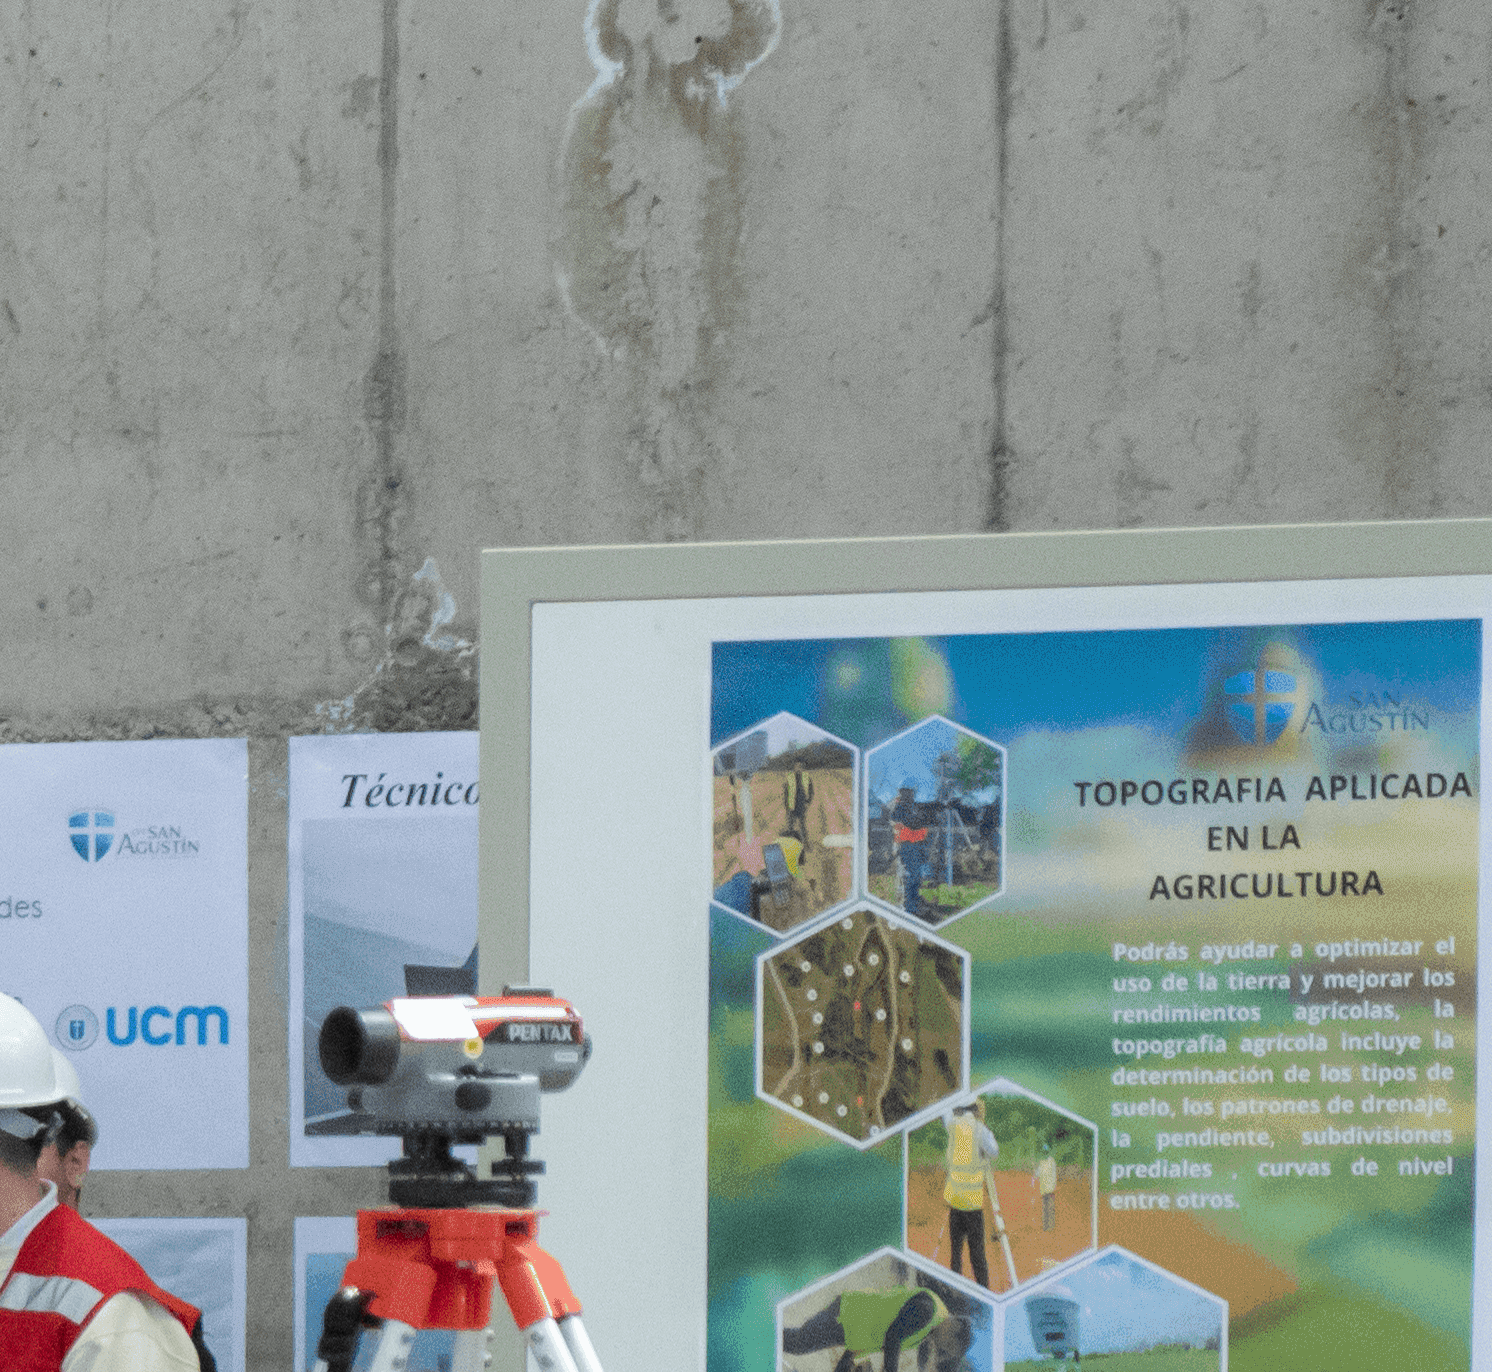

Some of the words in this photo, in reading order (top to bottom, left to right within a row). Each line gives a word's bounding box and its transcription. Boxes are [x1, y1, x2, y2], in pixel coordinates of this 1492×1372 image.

[1348, 690, 1401, 708] SAN
[341, 771, 480, 808] Técnico
[1073, 777, 1288, 807] TOPOGRAFIA
[1305, 772, 1473, 801] APLICADA
[148, 825, 182, 839] SAN
[1207, 825, 1249, 852] EN
[1262, 824, 1302, 851] LA
[1149, 869, 1385, 901] AGRICULTURA
[1113, 941, 1189, 961] Podrás
[1200, 940, 1279, 964] ayudar
[1289, 943, 1303, 958] a
[1315, 938, 1424, 962] optimizar
[1435, 936, 1456, 956] el
[1113, 977, 1152, 992] uso
[1161, 972, 1189, 992] de
[1198, 971, 1218, 991] la
[1228, 971, 1291, 990] tierra
[1301, 974, 1314, 995] y
[1323, 969, 1413, 993] mejorar
[1423, 967, 1456, 987] los
[1113, 1003, 1261, 1023] rendimientos
[1293, 1000, 1401, 1026] agrícolas,
[1434, 999, 1455, 1018] la
[508, 1022, 574, 1042] PENTAX
[1112, 1034, 1227, 1059] topografía
[1239, 1033, 1328, 1058] agrícola
[1341, 1031, 1423, 1055] incluye
[1434, 1029, 1455, 1050] la
[1111, 1065, 1274, 1086] determinación
[1283, 1064, 1311, 1083] de
[1320, 1063, 1353, 1083] los
[1361, 1063, 1417, 1087] tipos
[1426, 1062, 1455, 1082] de
[1110, 1097, 1176, 1119] suelo,
[1181, 1096, 1214, 1117] los
[1220, 1096, 1321, 1119] patrones
[1326, 1094, 1355, 1114] de
[1361, 1093, 1453, 1118] drenaje,
[1110, 1128, 1131, 1148] la
[1156, 1127, 1275, 1152] pendiente,
[1301, 1125, 1454, 1146] subdivisiones
[1110, 1159, 1213, 1184] prediales
[1257, 1160, 1332, 1177] curvas
[1351, 1157, 1379, 1176] de
[1398, 1156, 1454, 1176] nivel
[1109, 1191, 1171, 1210] entre
[1176, 1190, 1241, 1210] otros.
